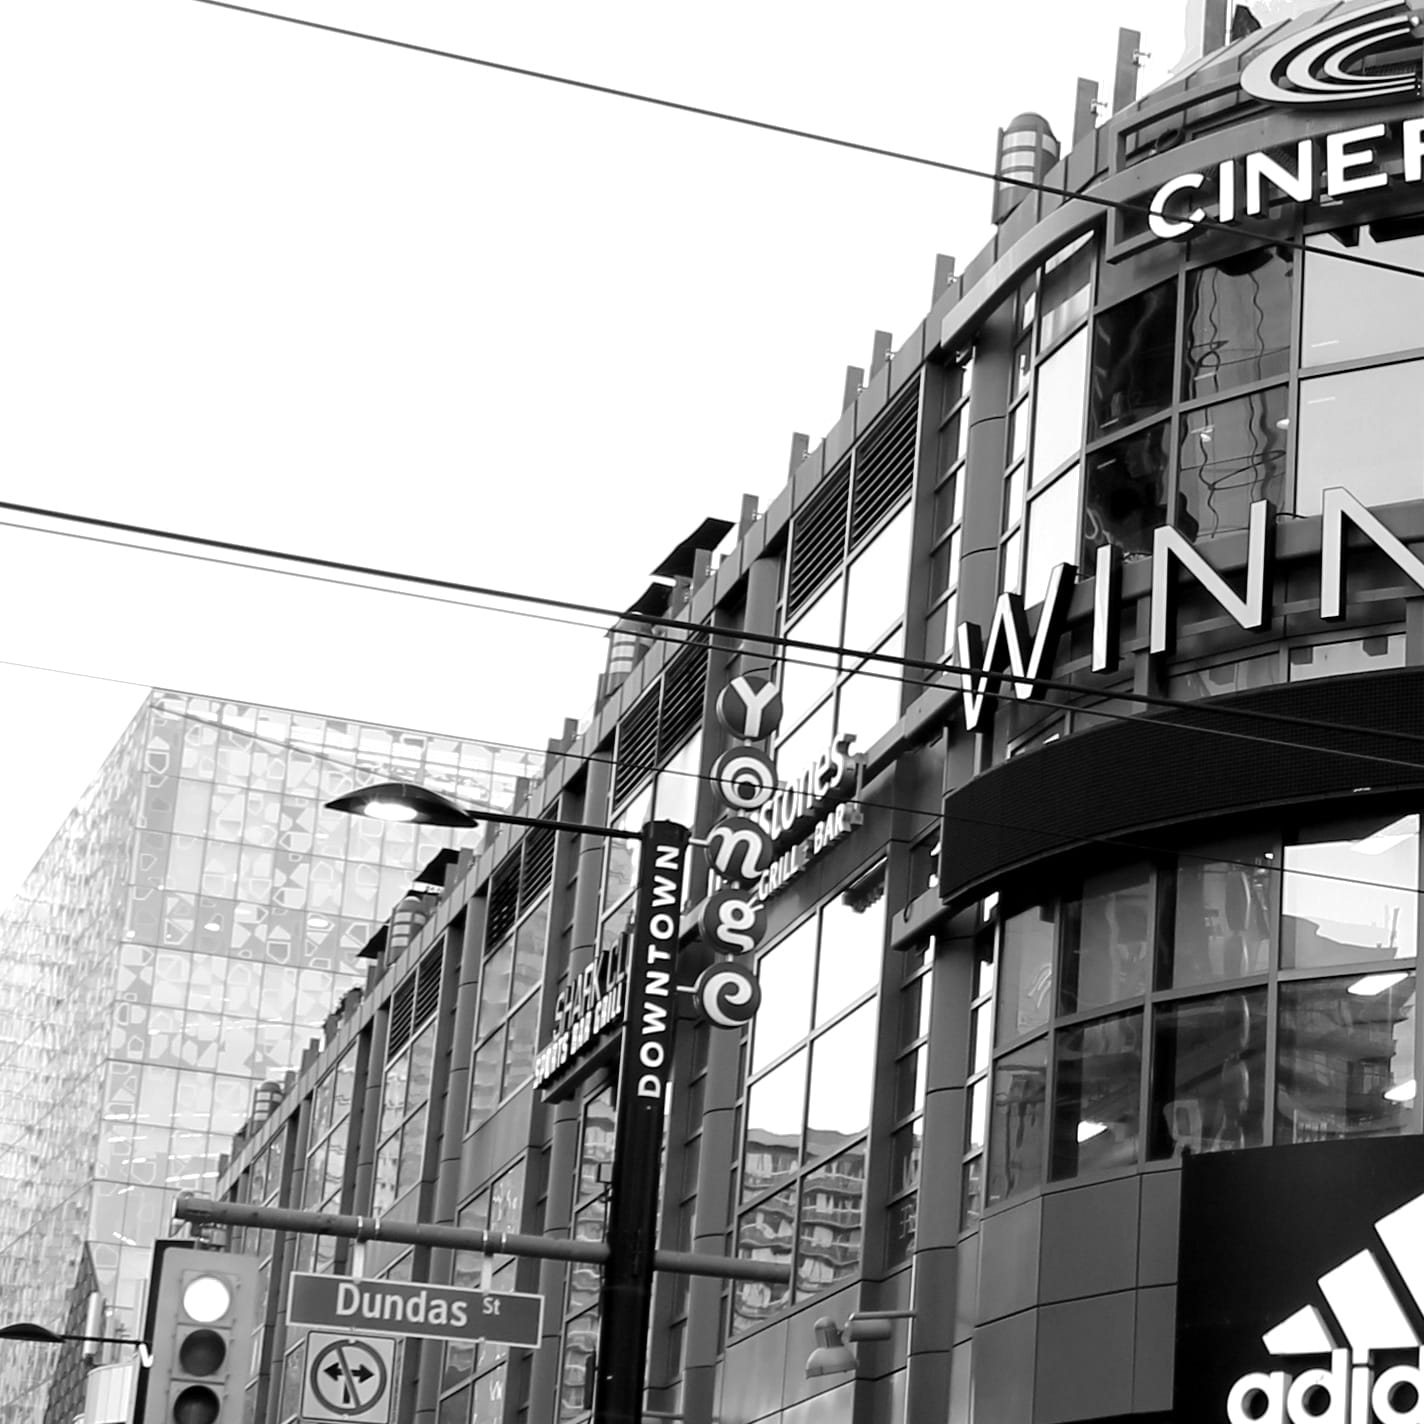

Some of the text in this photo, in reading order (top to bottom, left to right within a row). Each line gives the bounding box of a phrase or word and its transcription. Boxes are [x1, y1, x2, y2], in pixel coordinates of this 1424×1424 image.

[703, 675, 781, 1026] Yonge
[813, 802, 847, 856] BAR
[637, 845, 680, 1099] DOWNTOWN
[336, 1282, 501, 1327] Dundas St
